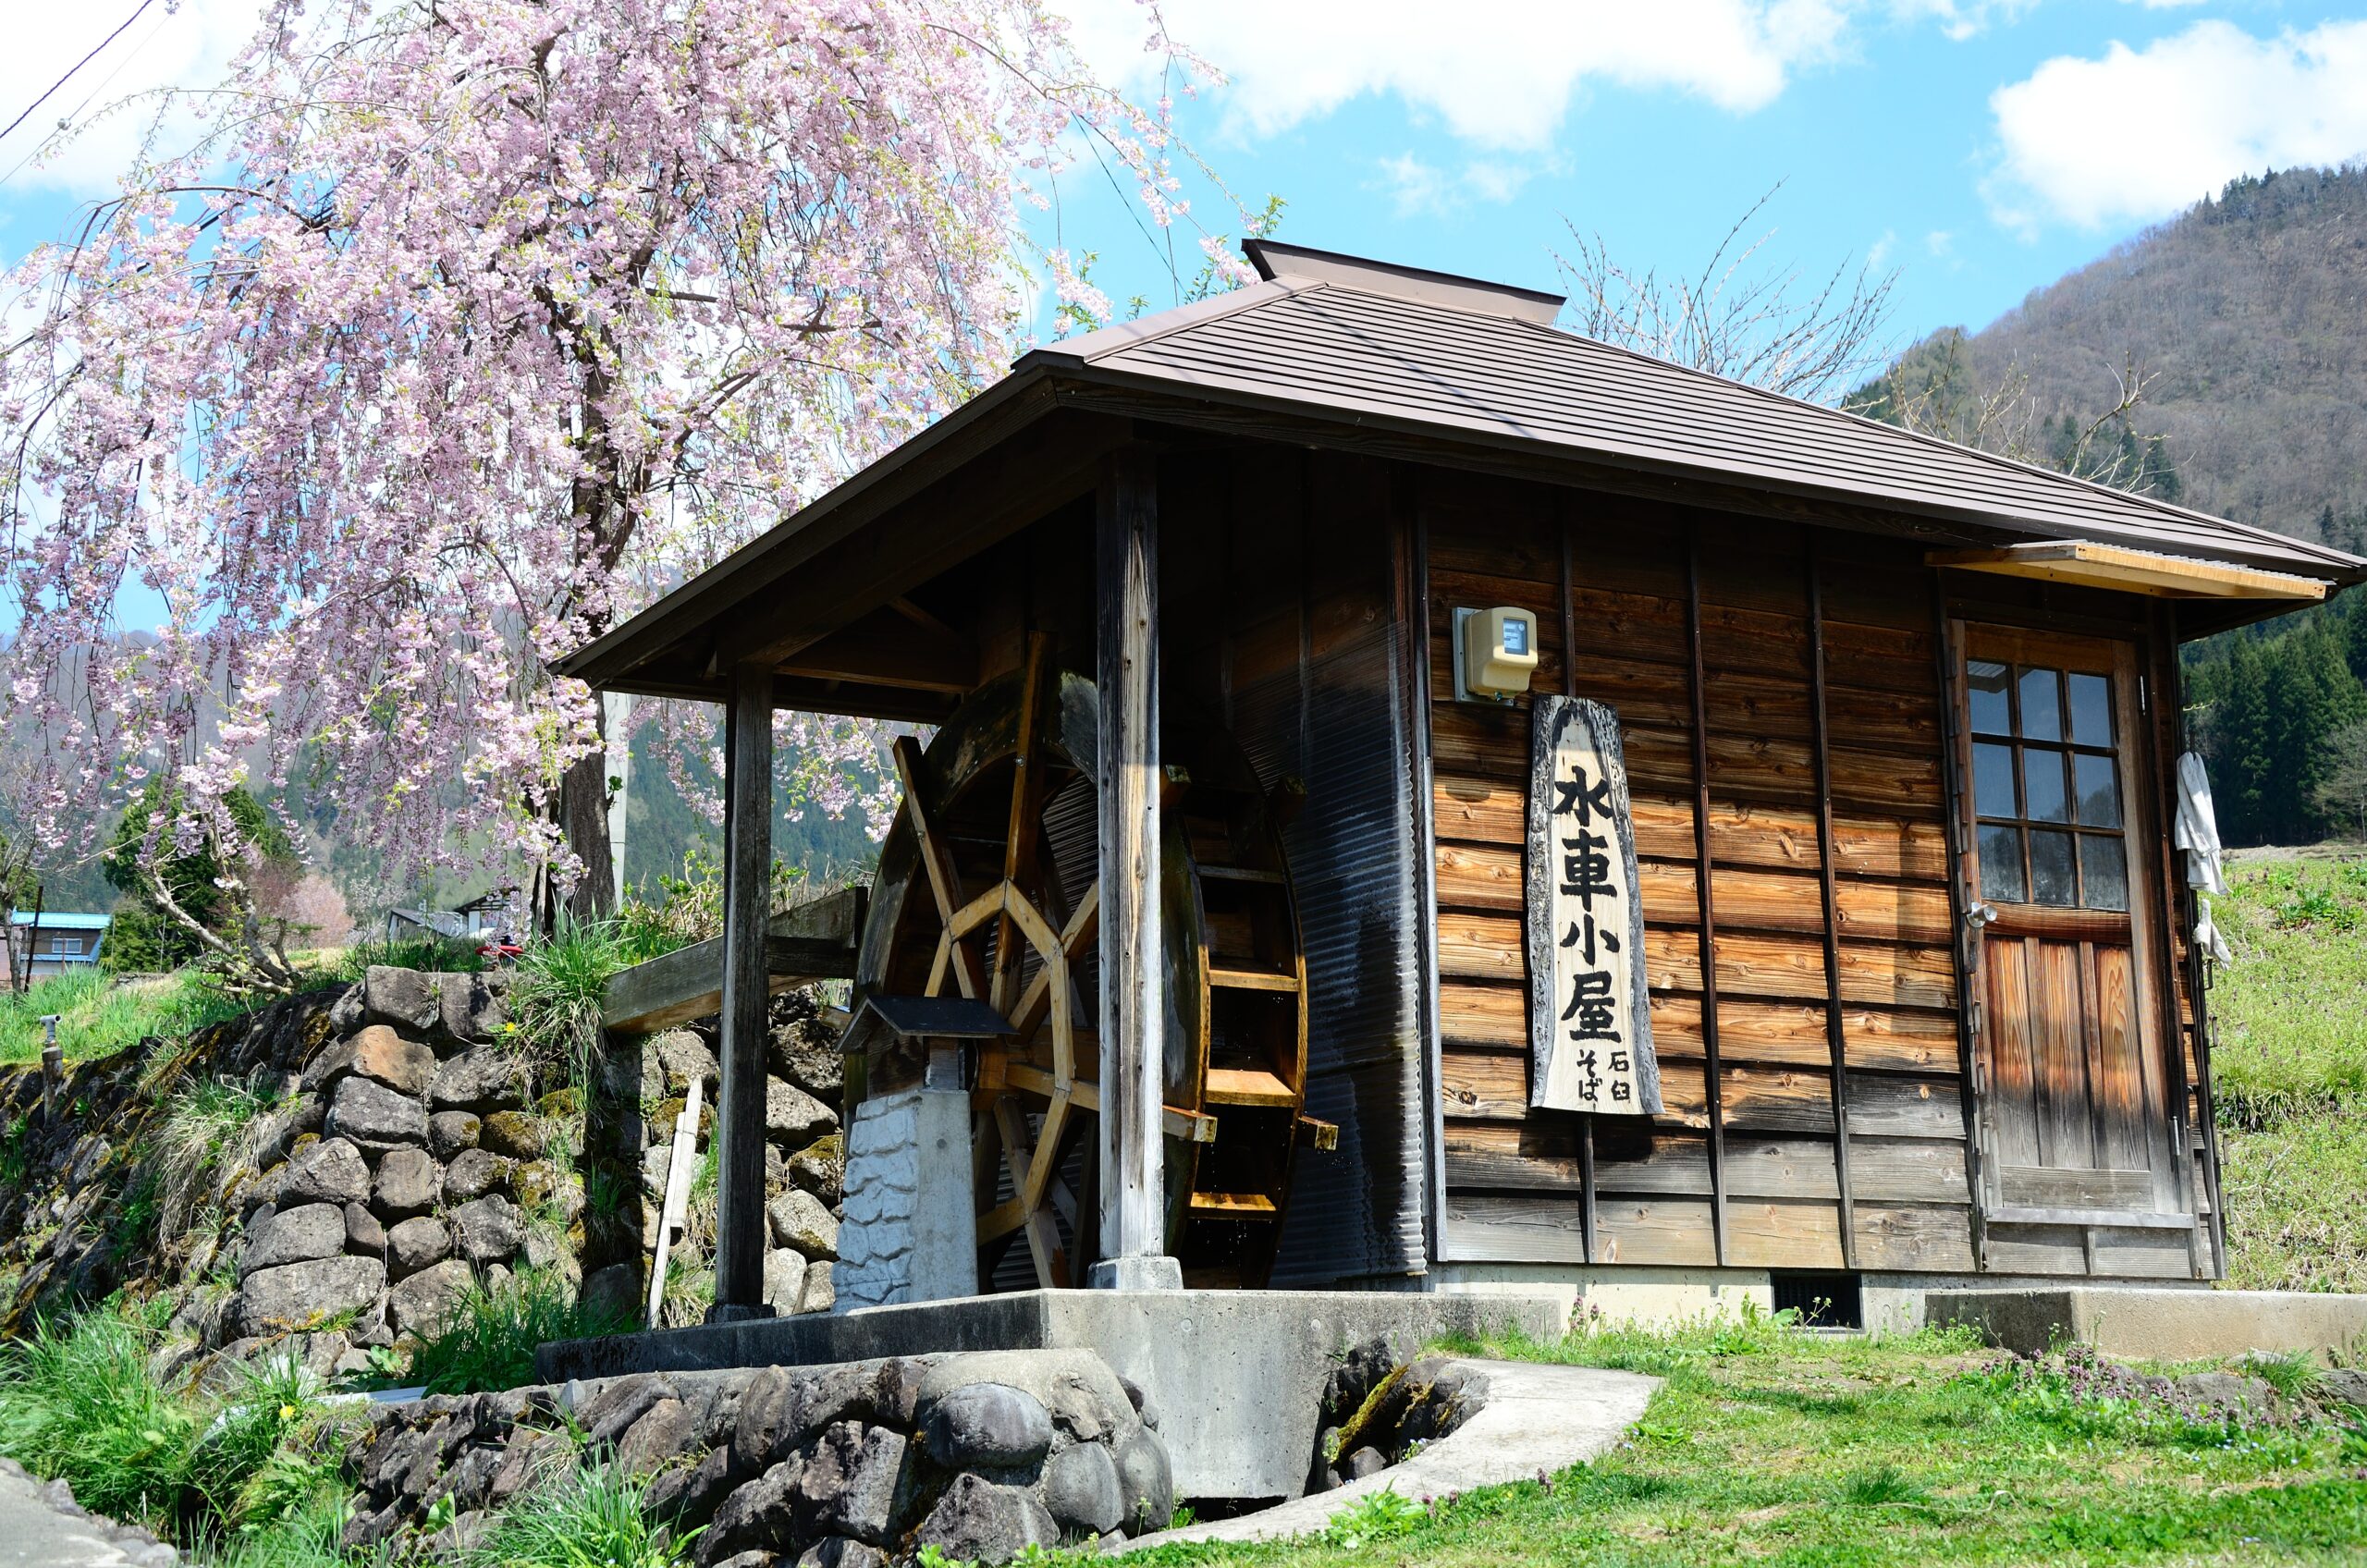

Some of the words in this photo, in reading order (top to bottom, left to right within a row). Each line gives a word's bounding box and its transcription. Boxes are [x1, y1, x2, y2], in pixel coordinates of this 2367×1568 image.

[1552, 766, 1622, 1043] 水車小屋
[1576, 1049, 1603, 1102] そば
[1608, 1052, 1630, 1101] 石臼
